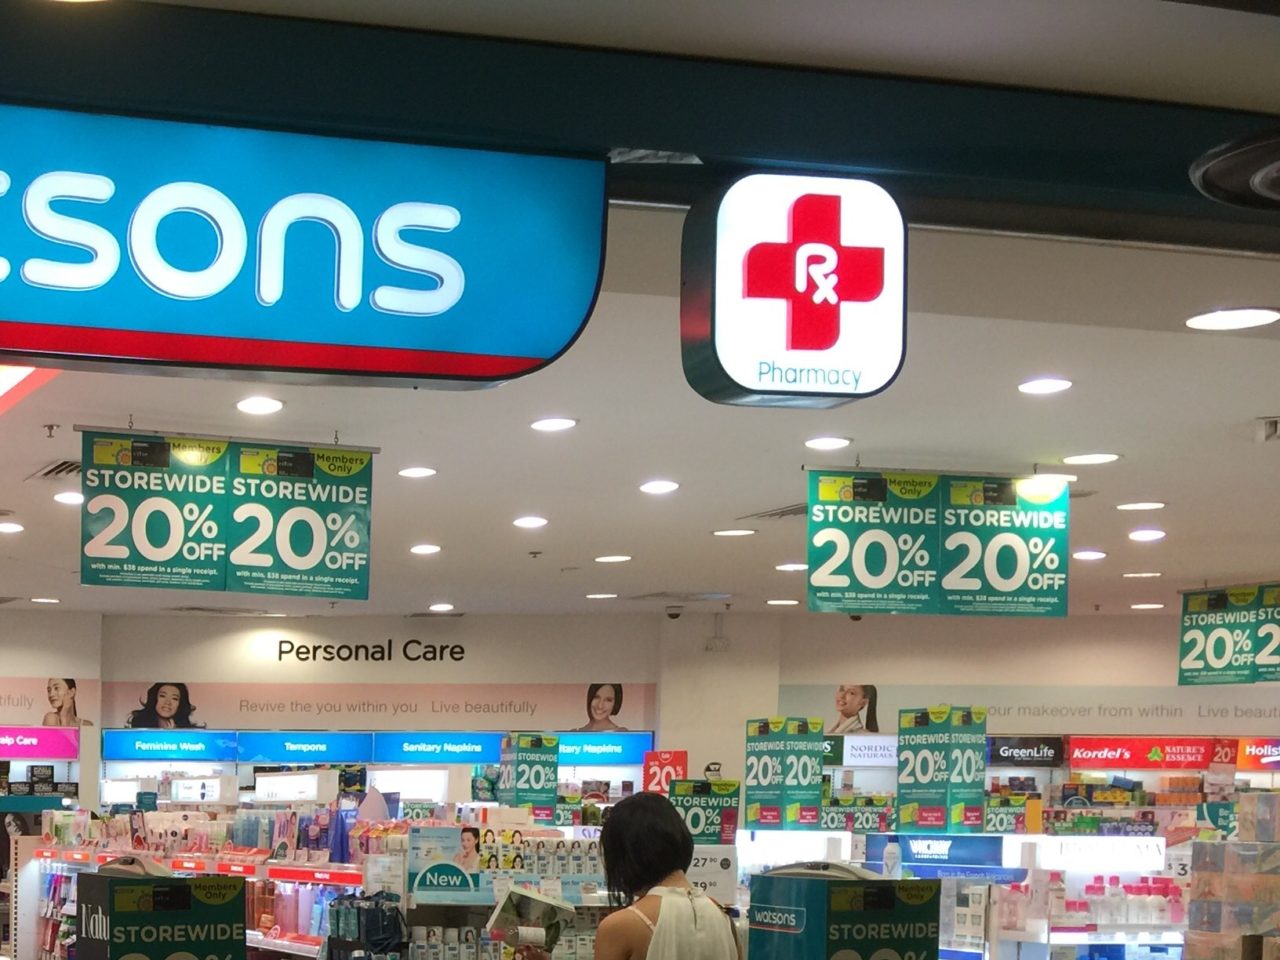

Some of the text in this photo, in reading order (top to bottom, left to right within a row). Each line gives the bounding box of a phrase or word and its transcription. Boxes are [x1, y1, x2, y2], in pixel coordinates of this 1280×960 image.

[758, 360, 862, 391] Pharmacy
[172, 442, 222, 454] Members
[316, 453, 365, 466] Members
[328, 461, 353, 474] Only
[86, 469, 226, 495] STOREWIDE
[888, 478, 933, 489] Members
[232, 478, 368, 505] STOREWIDE
[899, 487, 923, 496] Only
[811, 505, 937, 525] STOREWIDE
[944, 511, 1066, 529] STOREWIDE
[84, 494, 219, 562] 20%
[229, 503, 360, 570] 20%
[182, 542, 226, 561] OFF
[810, 527, 930, 589] 20%
[325, 552, 368, 570] OFF
[941, 531, 1059, 592] 20%
[897, 570, 937, 587] OFF
[1028, 573, 1066, 590] OFF
[1184, 610, 1257, 626] STOREWIDE
[278, 639, 465, 662] Personal Care
[1181, 628, 1253, 670] 20%
[1231, 653, 1255, 666] OFF
[239, 700, 538, 717] Revive the you within you Live beautifully
[1017, 704, 1229, 718] makeover from within Live
[16, 736, 38, 746] Care
[899, 733, 950, 746] STOREWIDE
[951, 732, 986, 745] STOREWIDE
[135, 741, 206, 751] Feminine Wash
[402, 742, 482, 754] Sanitary Napkins
[583, 743, 623, 754] Napkins
[746, 741, 785, 752] STOREWIDE
[850, 744, 893, 753] NORDIC
[999, 744, 1055, 758] GreenLife
[517, 752, 558, 762] STOREWIDE
[1072, 747, 1131, 760] Kordel's
[1166, 754, 1203, 762] ESSENCE
[933, 771, 949, 782] OFF
[671, 796, 739, 808] STOREWIDE
[426, 872, 463, 887] New
[194, 882, 238, 892] Members
[205, 890, 228, 901] Only
[754, 910, 796, 926] watsons
[113, 923, 244, 943] STOREWIDE
[829, 922, 938, 940] STOREWIDE
